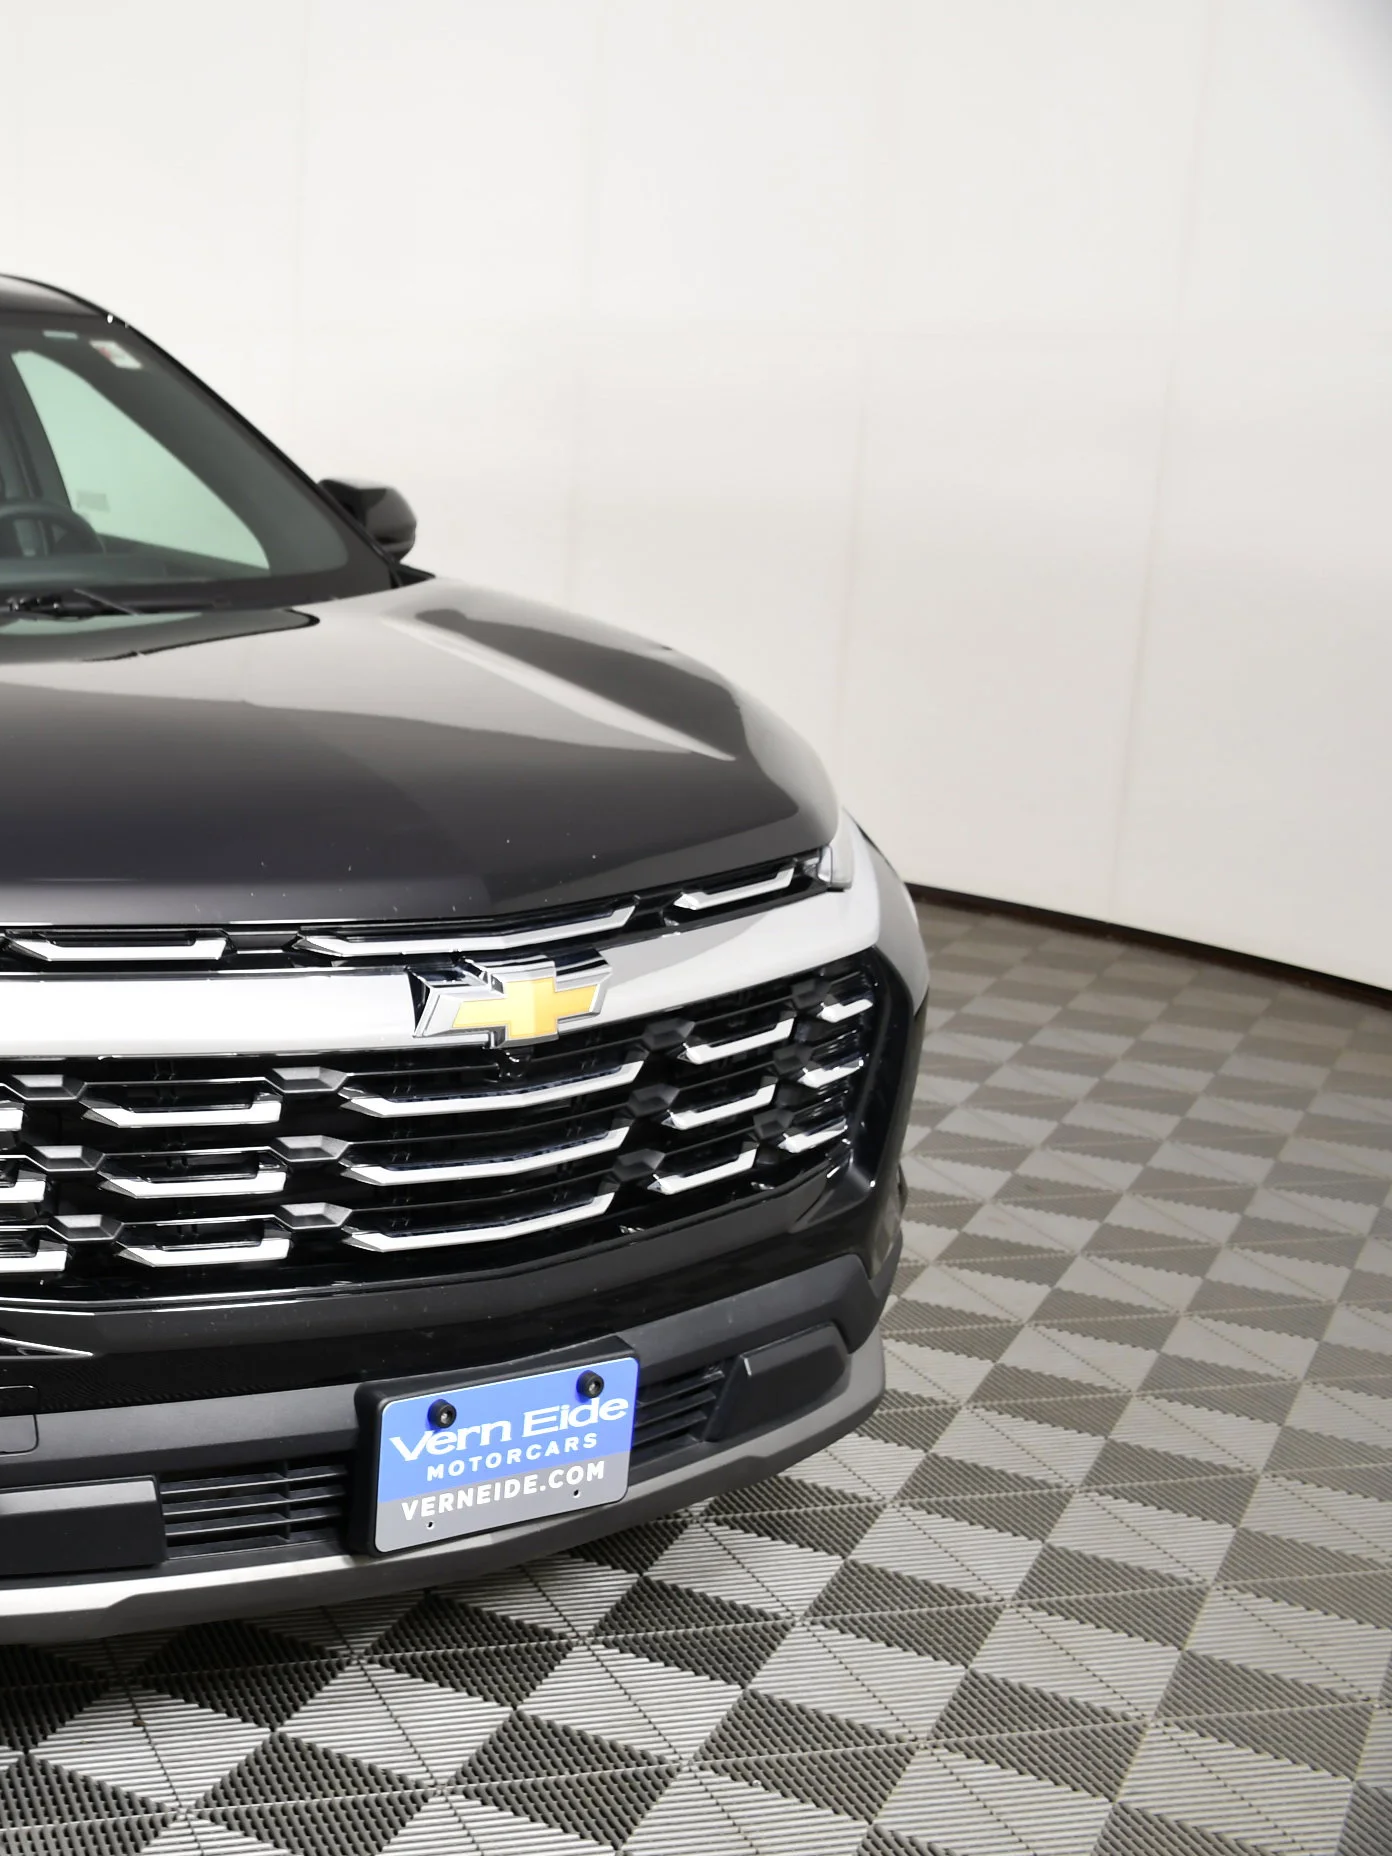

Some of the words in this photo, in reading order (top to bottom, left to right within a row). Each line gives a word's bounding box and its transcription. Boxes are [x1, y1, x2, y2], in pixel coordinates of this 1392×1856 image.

[389, 1419, 512, 1462] Vern
[521, 1397, 629, 1438] Eide
[426, 1432, 598, 1482] MOTORCARS
[401, 1460, 606, 1521] VERNEIDE.COM
